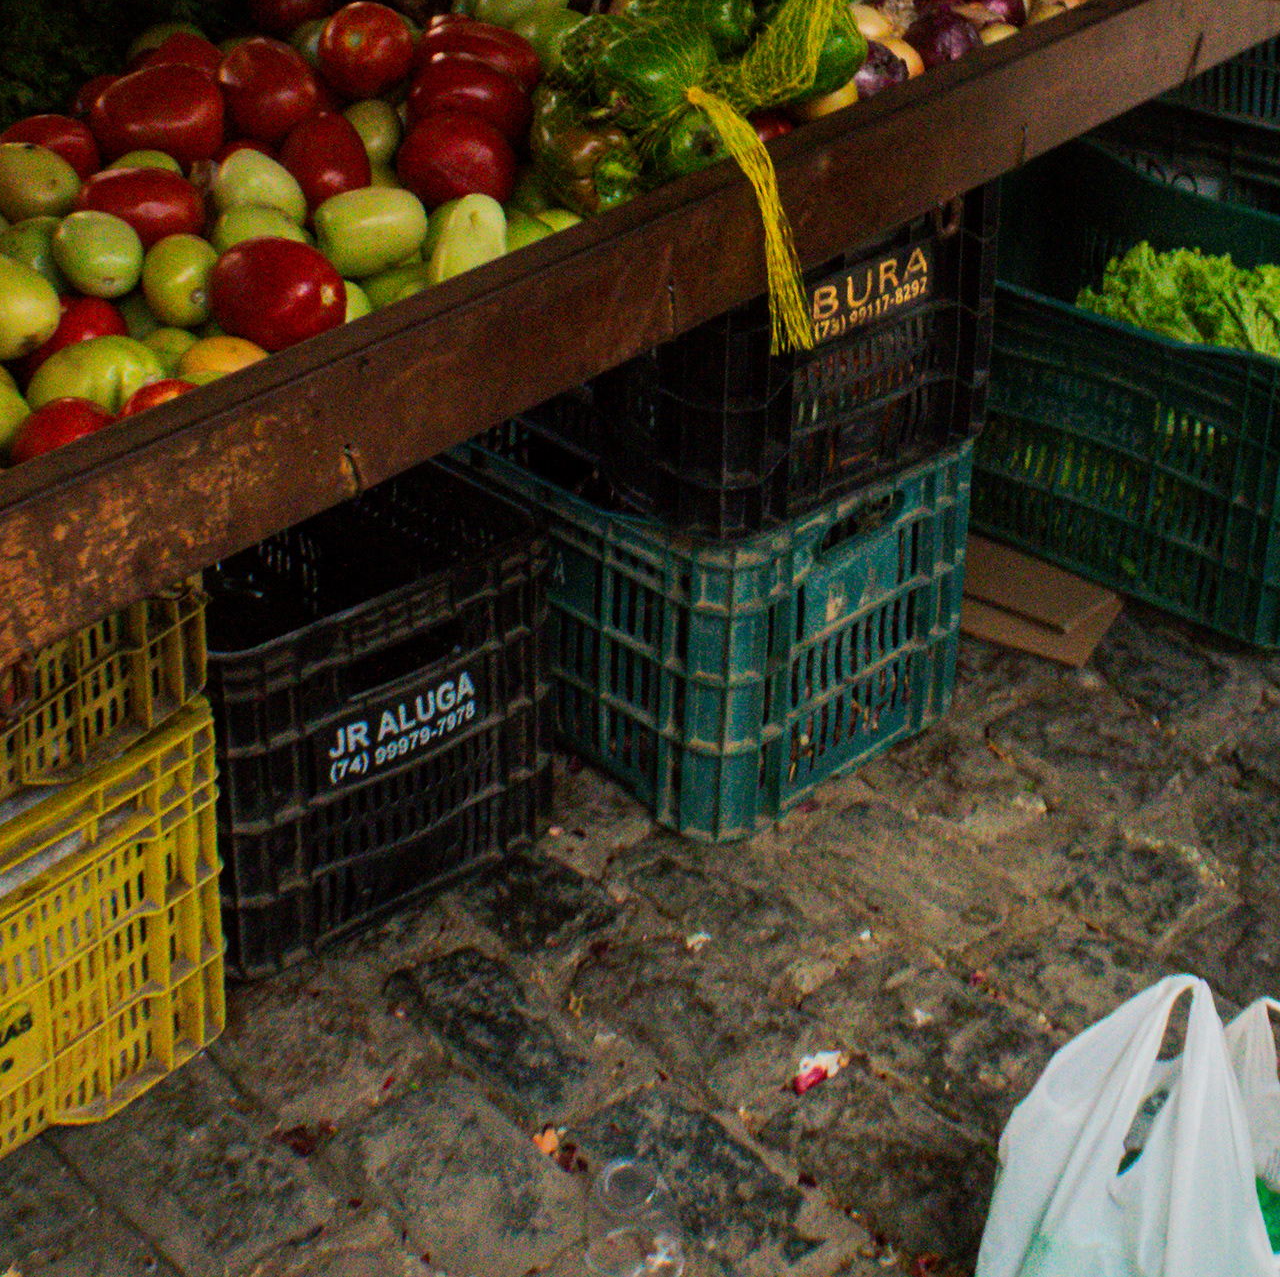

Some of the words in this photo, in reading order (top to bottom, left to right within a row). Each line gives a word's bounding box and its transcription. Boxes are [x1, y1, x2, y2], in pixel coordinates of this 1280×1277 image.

[813, 247, 928, 320] BURA
[328, 720, 371, 759] JR
[377, 671, 476, 742] ALUGA
[329, 750, 370, 784] (74)
